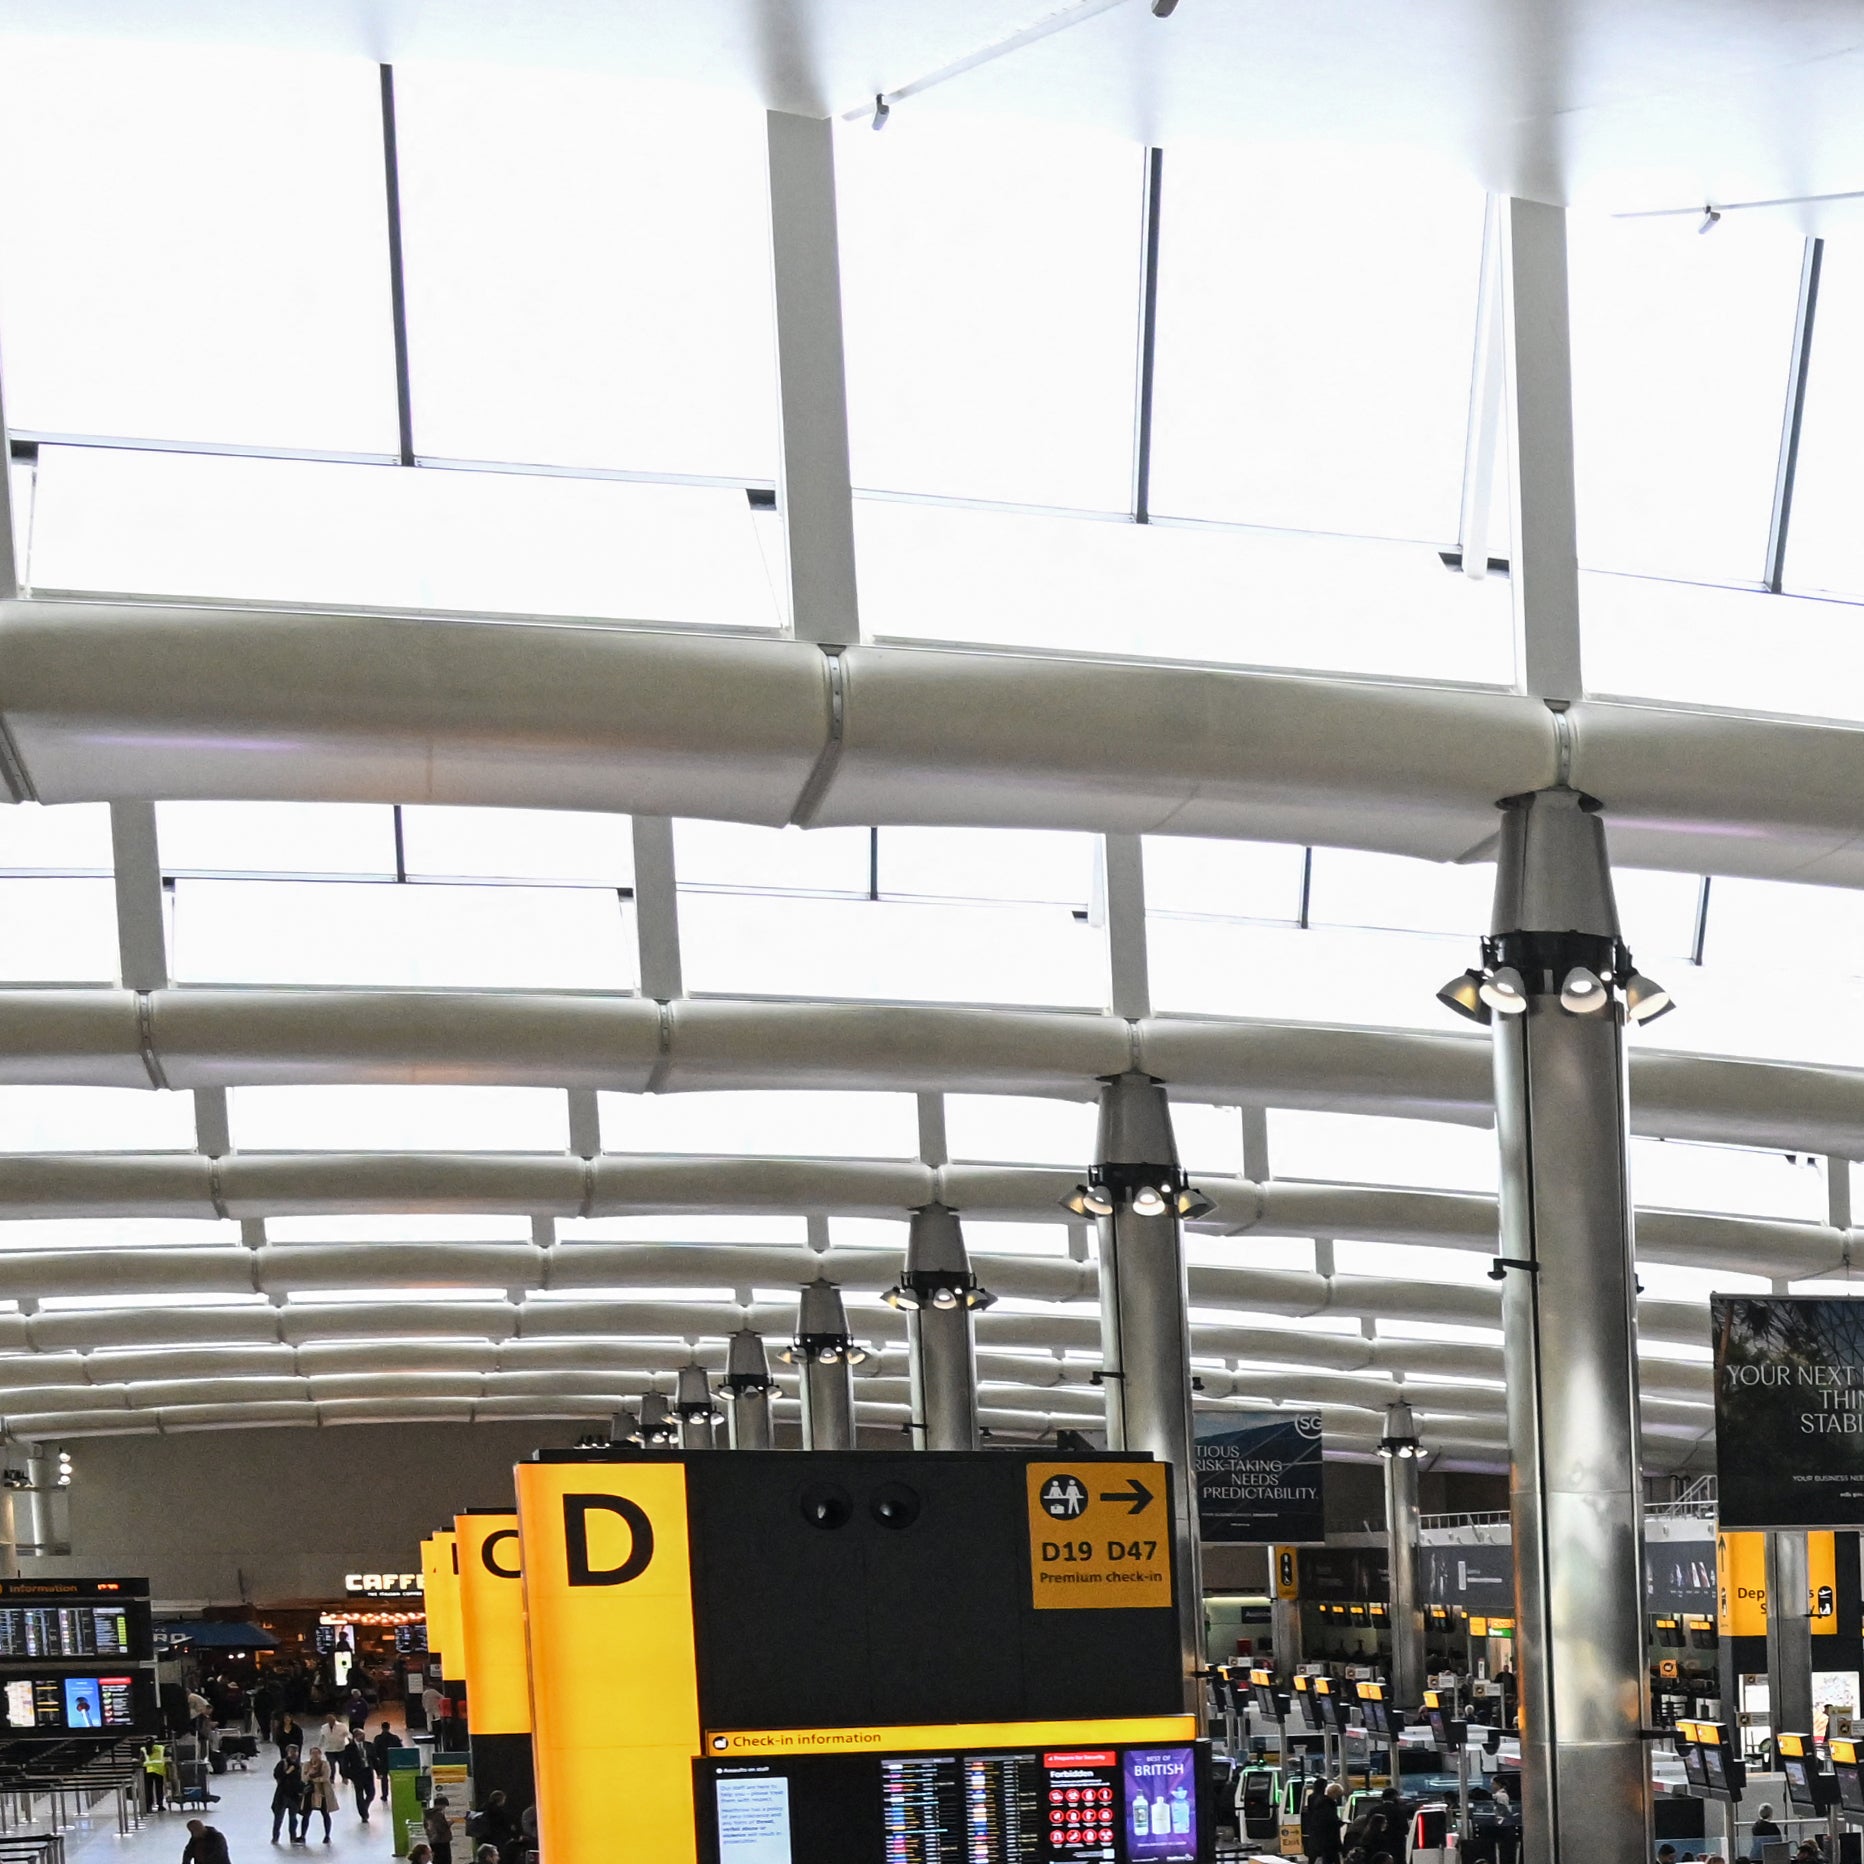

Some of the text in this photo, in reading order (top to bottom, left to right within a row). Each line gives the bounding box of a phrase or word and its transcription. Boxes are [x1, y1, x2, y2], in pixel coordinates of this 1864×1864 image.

[1727, 1366, 1791, 1385] YOUR
[1798, 1366, 1855, 1385] NEXT
[1300, 1416, 1321, 1429] SG
[1232, 1473, 1278, 1486] NEEDS
[1203, 1487, 1318, 1499] PREDICTABILITY.
[565, 1494, 655, 1586] D
[1042, 1541, 1157, 1561] D19 D47
[1040, 1572, 1162, 1582] Premium check-in
[733, 1733, 881, 1746] Check-in information
[1050, 1770, 1093, 1778] Forbidden
[1134, 1764, 1184, 1776] BRITISH
